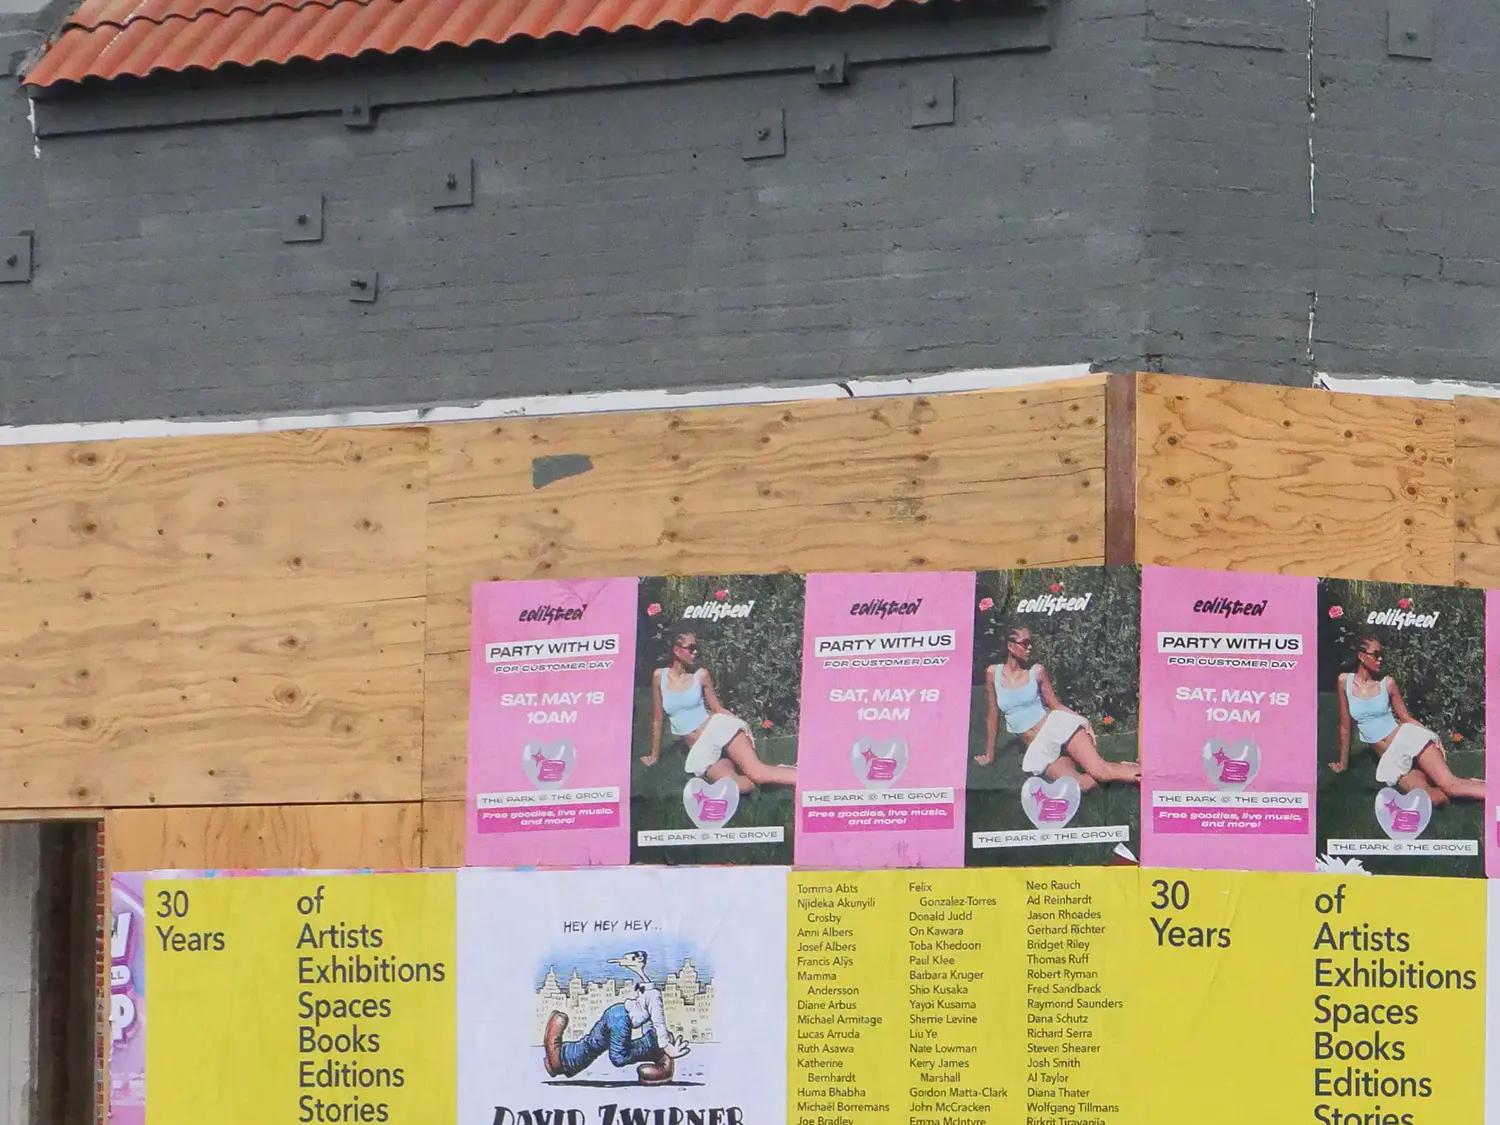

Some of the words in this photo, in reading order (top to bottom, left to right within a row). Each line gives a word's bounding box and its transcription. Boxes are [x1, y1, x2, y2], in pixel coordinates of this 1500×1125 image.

[490, 644, 543, 658] PARTY
[548, 641, 589, 654] WITH
[593, 639, 615, 650] US
[820, 640, 876, 652] PARTY
[880, 637, 924, 649] WITH
[928, 635, 951, 646] US
[1163, 637, 1222, 649] PARTY
[1226, 638, 1270, 649] WITH
[1275, 639, 1299, 649] US
[1169, 657, 1194, 665] FOR
[1198, 658, 1268, 667] CUSTOMER
[1271, 660, 1295, 668] DAY
[500, 693, 537, 707] SAT,
[541, 692, 581, 705] MAY
[586, 691, 605, 704] 18
[1176, 688, 1216, 703] SAT,
[1221, 691, 1265, 704] MAY
[1269, 692, 1289, 705] 18
[527, 711, 576, 724] 10AM
[1206, 709, 1260, 723] 10AM
[1262, 796, 1302, 804] GROVE
[157, 891, 188, 918] 30
[297, 886, 324, 914] of
[1151, 880, 1189, 910] 30
[1315, 884, 1346, 913] of
[564, 921, 588, 933] HEY
[594, 920, 618, 932] HEY
[910, 911, 944, 921] Donald
[948, 911, 972, 921] Judd
[156, 925, 225, 951] Years
[296, 922, 382, 948] Artists
[1150, 917, 1230, 948] Years
[1313, 922, 1409, 952] Artists
[299, 955, 445, 983] Exhibitions
[910, 956, 929, 965] Paul
[932, 956, 955, 965] Klee
[1316, 958, 1476, 989] Exhibitions
[1027, 970, 1060, 979] Robert
[1064, 970, 1097, 981] Ryman
[299, 991, 391, 1023] Spaces
[798, 1000, 825, 1010] Diane
[829, 1000, 856, 1010] Arbus
[1314, 995, 1418, 1032] Spaces
[300, 1025, 379, 1053] Books
[1027, 1029, 1063, 1038] Richard
[1066, 1029, 1092, 1038] Serra
[1315, 1031, 1405, 1060] Books
[300, 1059, 404, 1087] Editions
[1315, 1067, 1432, 1097] Editions
[299, 1095, 388, 1122] Stories
